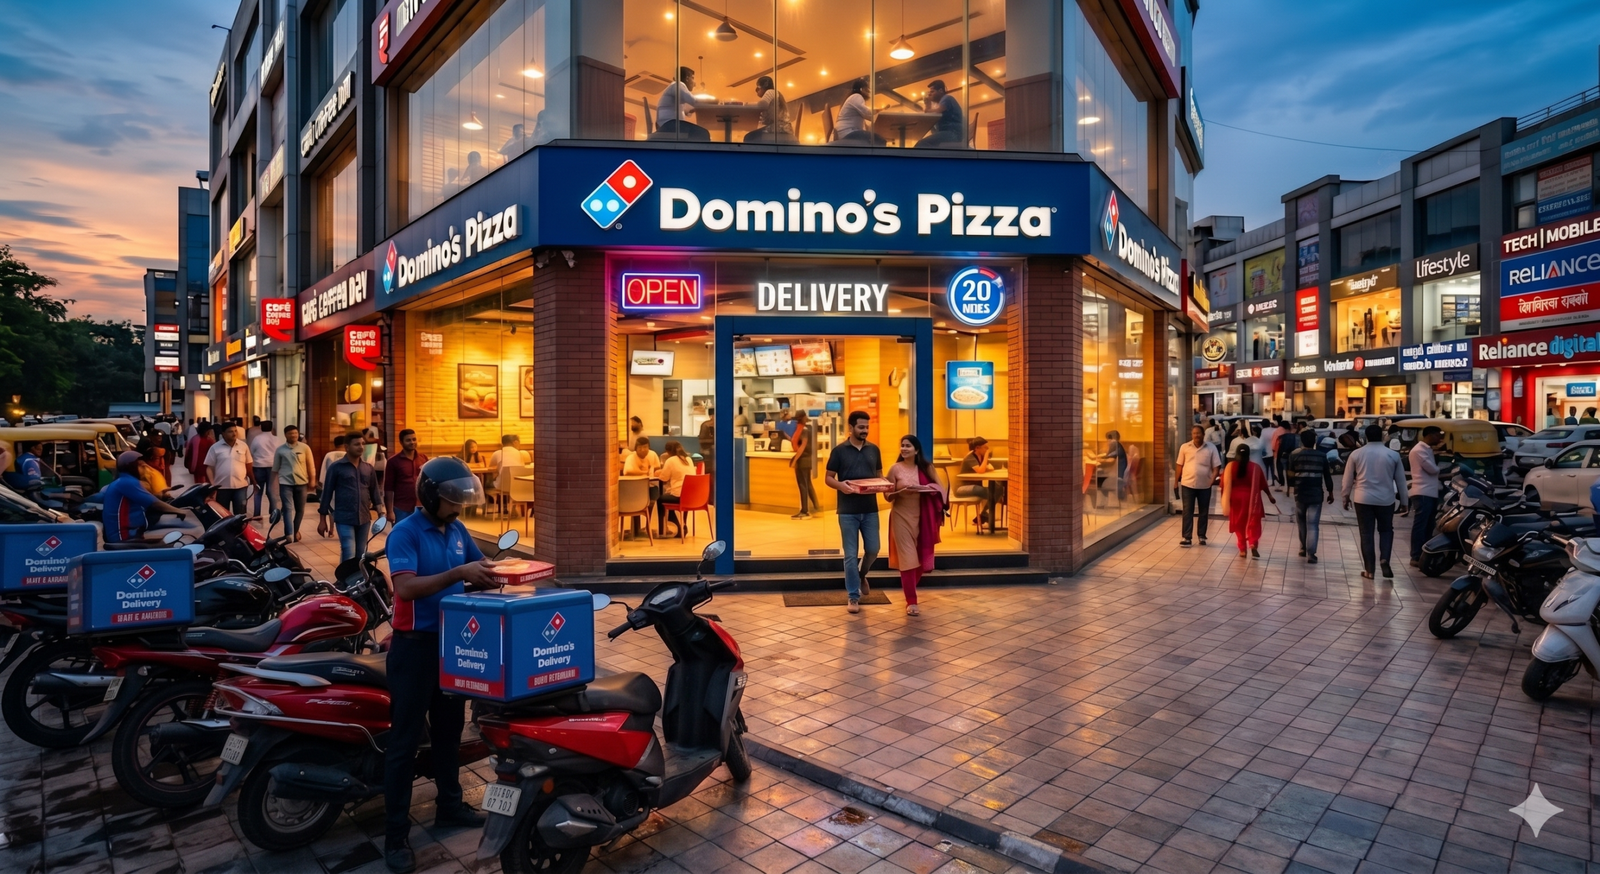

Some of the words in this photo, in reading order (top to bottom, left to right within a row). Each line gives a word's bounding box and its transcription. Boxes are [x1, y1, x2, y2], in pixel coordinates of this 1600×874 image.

[659, 187, 902, 235] Domino's
[917, 192, 1052, 236] Pizza
[398, 225, 462, 289] Domino's
[464, 204, 518, 258] Pizza
[1503, 233, 1538, 253] TECH
[1545, 217, 1600, 244] MOBILE
[1117, 221, 1161, 284] Domino's
[626, 278, 698, 305] OPEN
[757, 282, 889, 312] DELIVERY
[962, 279, 992, 302] 20
[1478, 337, 1549, 361] Reliance
[1549, 332, 1600, 360] digital
[30, 565, 67, 574] Delivery
[115, 588, 167, 601] Domino's
[122, 599, 162, 610] Delivery
[532, 640, 575, 658] Domino's
[457, 658, 486, 674] Delivery
[537, 655, 571, 669] Delivery
